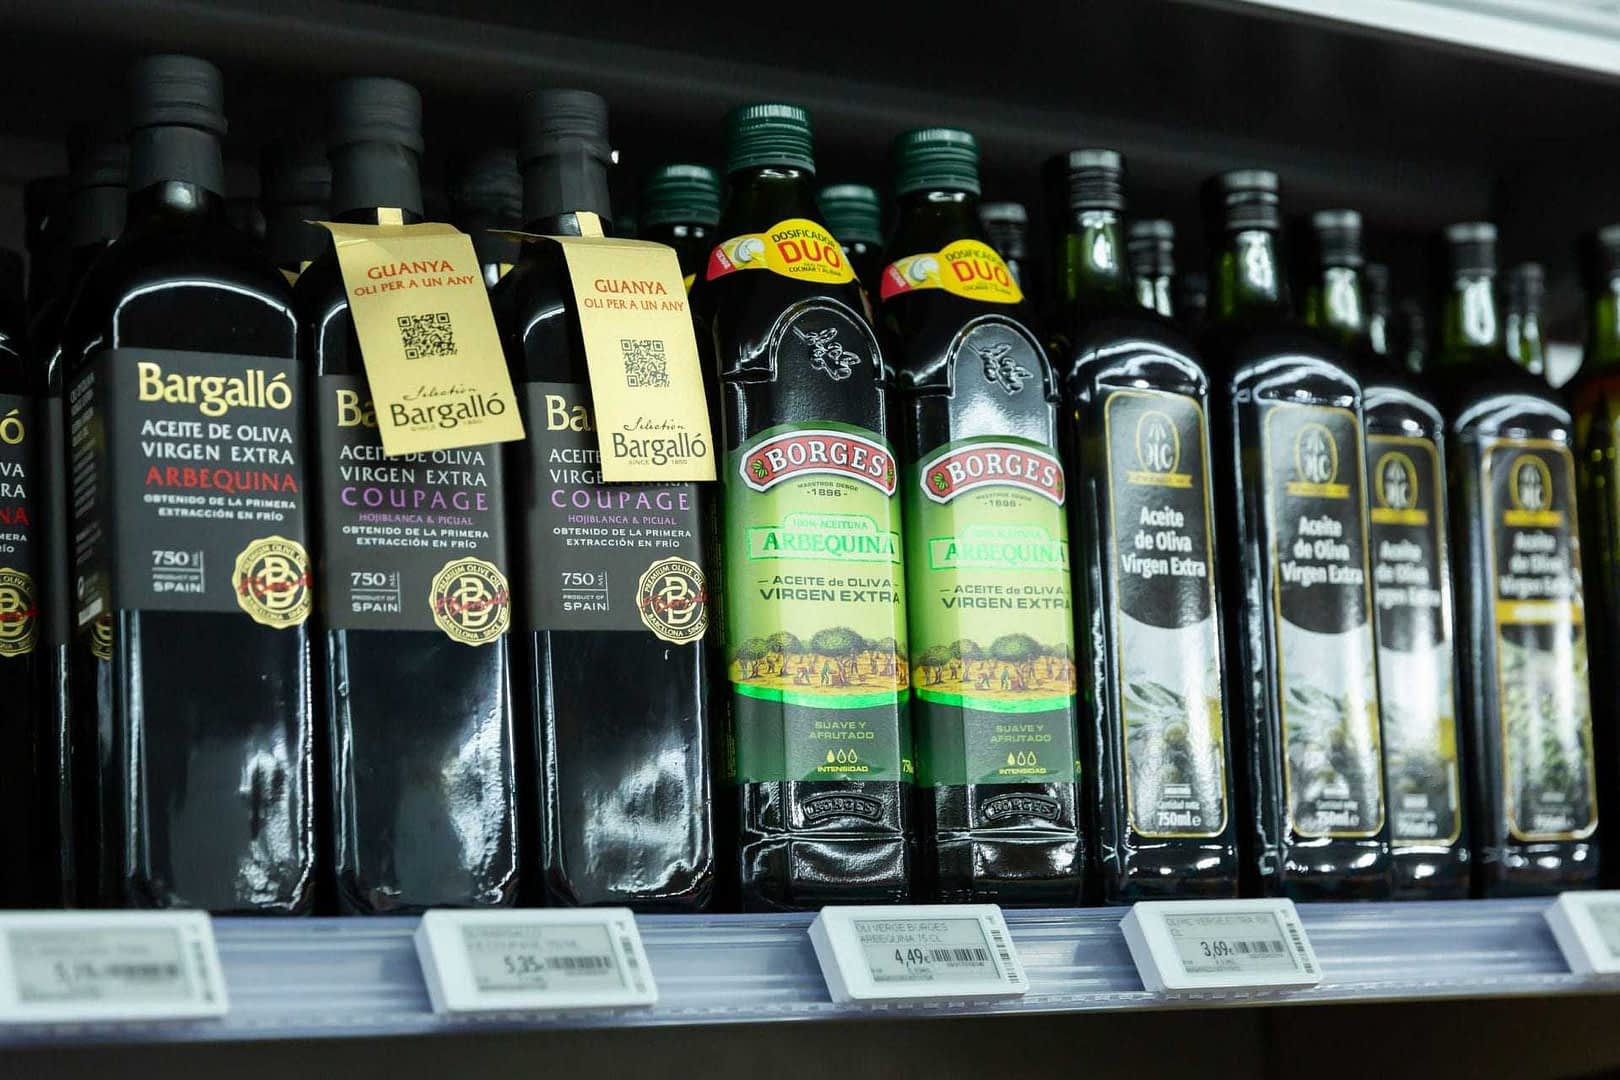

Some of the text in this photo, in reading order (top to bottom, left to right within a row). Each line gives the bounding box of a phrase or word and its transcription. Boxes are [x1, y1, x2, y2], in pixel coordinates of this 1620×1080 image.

[777, 239, 840, 268] DUO
[367, 260, 454, 280] GUANYA
[952, 260, 1009, 287] DUO
[354, 275, 475, 296] OLI PER A UN ANY
[595, 279, 667, 295] GUANYA
[584, 298, 684, 312] OLI PER A UN ANY
[137, 361, 292, 417] Bargalló
[390, 392, 505, 429] Bargalló
[140, 419, 293, 444] ACEITE DE OLIVA
[141, 441, 294, 465] VIRGEN EXTRA
[612, 432, 706, 466] Bargalló
[432, 450, 486, 466] OLIVA
[765, 440, 885, 477] BORGES
[340, 466, 487, 487] VIRGEN EXTRA
[549, 469, 604, 485] VIRGE
[946, 453, 1057, 487] BORGES
[145, 466, 298, 493] ARBEQUINA
[144, 494, 296, 509] OBTENIDO DE LA PRIMERA
[341, 487, 489, 511] COUPAGE
[552, 489, 690, 511] COUPAGE
[158, 505, 283, 521] EXTRACCIÓN EN FRÍO
[359, 513, 423, 524] HOJIBLANCA
[438, 516, 473, 526] PICUAL
[568, 513, 677, 525] HOJIBLANCA & PICUAL
[1139, 506, 1185, 529] Aceite
[342, 526, 489, 538] OBTENIDO DE LA PRIMERA
[553, 526, 692, 538] OBTENIDO DE LA PRIMERA
[1298, 515, 1342, 537] Aceite
[0, 533, 27, 541] MERA
[356, 536, 477, 549] EXTRACCIÓN EN FRÍO
[566, 536, 680, 548] EXTRACCIÓN EN FRÍO
[763, 531, 896, 557] ARBEQUINA
[1134, 529, 1193, 553] de Oliva
[152, 550, 190, 566] 750
[1314, 539, 1350, 561] Oliva
[671, 564, 694, 576] OLIVE
[1121, 553, 1207, 579] Virgen Extra
[1281, 560, 1327, 587] Virgen
[153, 581, 201, 593] SPAIN
[351, 572, 386, 586] 750
[562, 572, 595, 586] 750
[772, 575, 892, 588] ACEITE de OLIVA
[760, 589, 900, 604] VIRGEN EXTRA
[954, 584, 1064, 595] ACEITE de OLIVA
[352, 603, 399, 612] SPAIN
[563, 601, 607, 612] SPAIN
[941, 597, 1012, 609] VIRGEN
[815, 721, 867, 729] SUAVE Y
[995, 725, 1034, 733] SUAVE
[808, 731, 875, 740] AFRUTADO
[990, 734, 1052, 743] AFRUTADO
[817, 765, 869, 773] INTENSIDAD
[1156, 811, 1191, 827] 750ml
